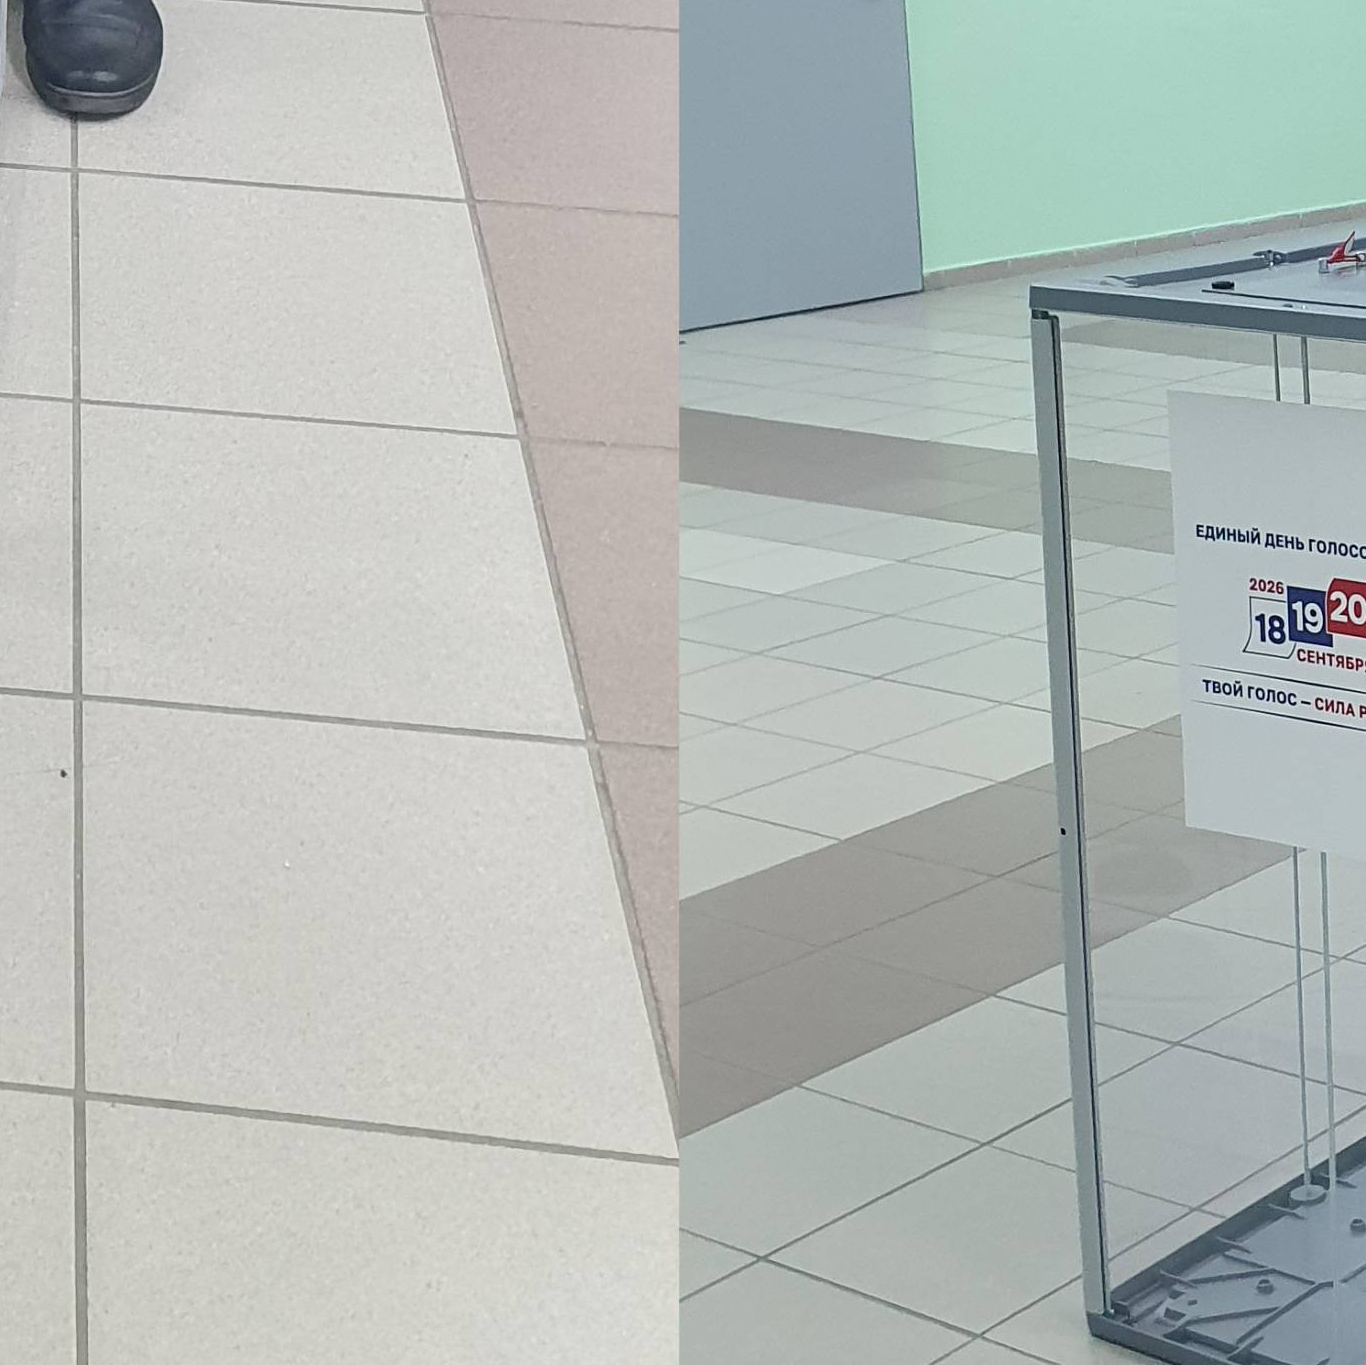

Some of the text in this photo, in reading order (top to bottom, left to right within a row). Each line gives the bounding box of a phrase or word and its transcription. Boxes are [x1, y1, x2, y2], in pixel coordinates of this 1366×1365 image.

[1195, 523, 1261, 545] ЕДИНЫЙ
[1264, 534, 1305, 551] ДЕНЬ
[1249, 577, 1285, 595] 2026
[1254, 613, 1287, 645] 18
[1291, 600, 1324, 634] 19
[1202, 679, 1244, 698] ТВОЙ
[1247, 685, 1298, 706] ГОЛОС
[1314, 697, 1356, 717] СИЛА
